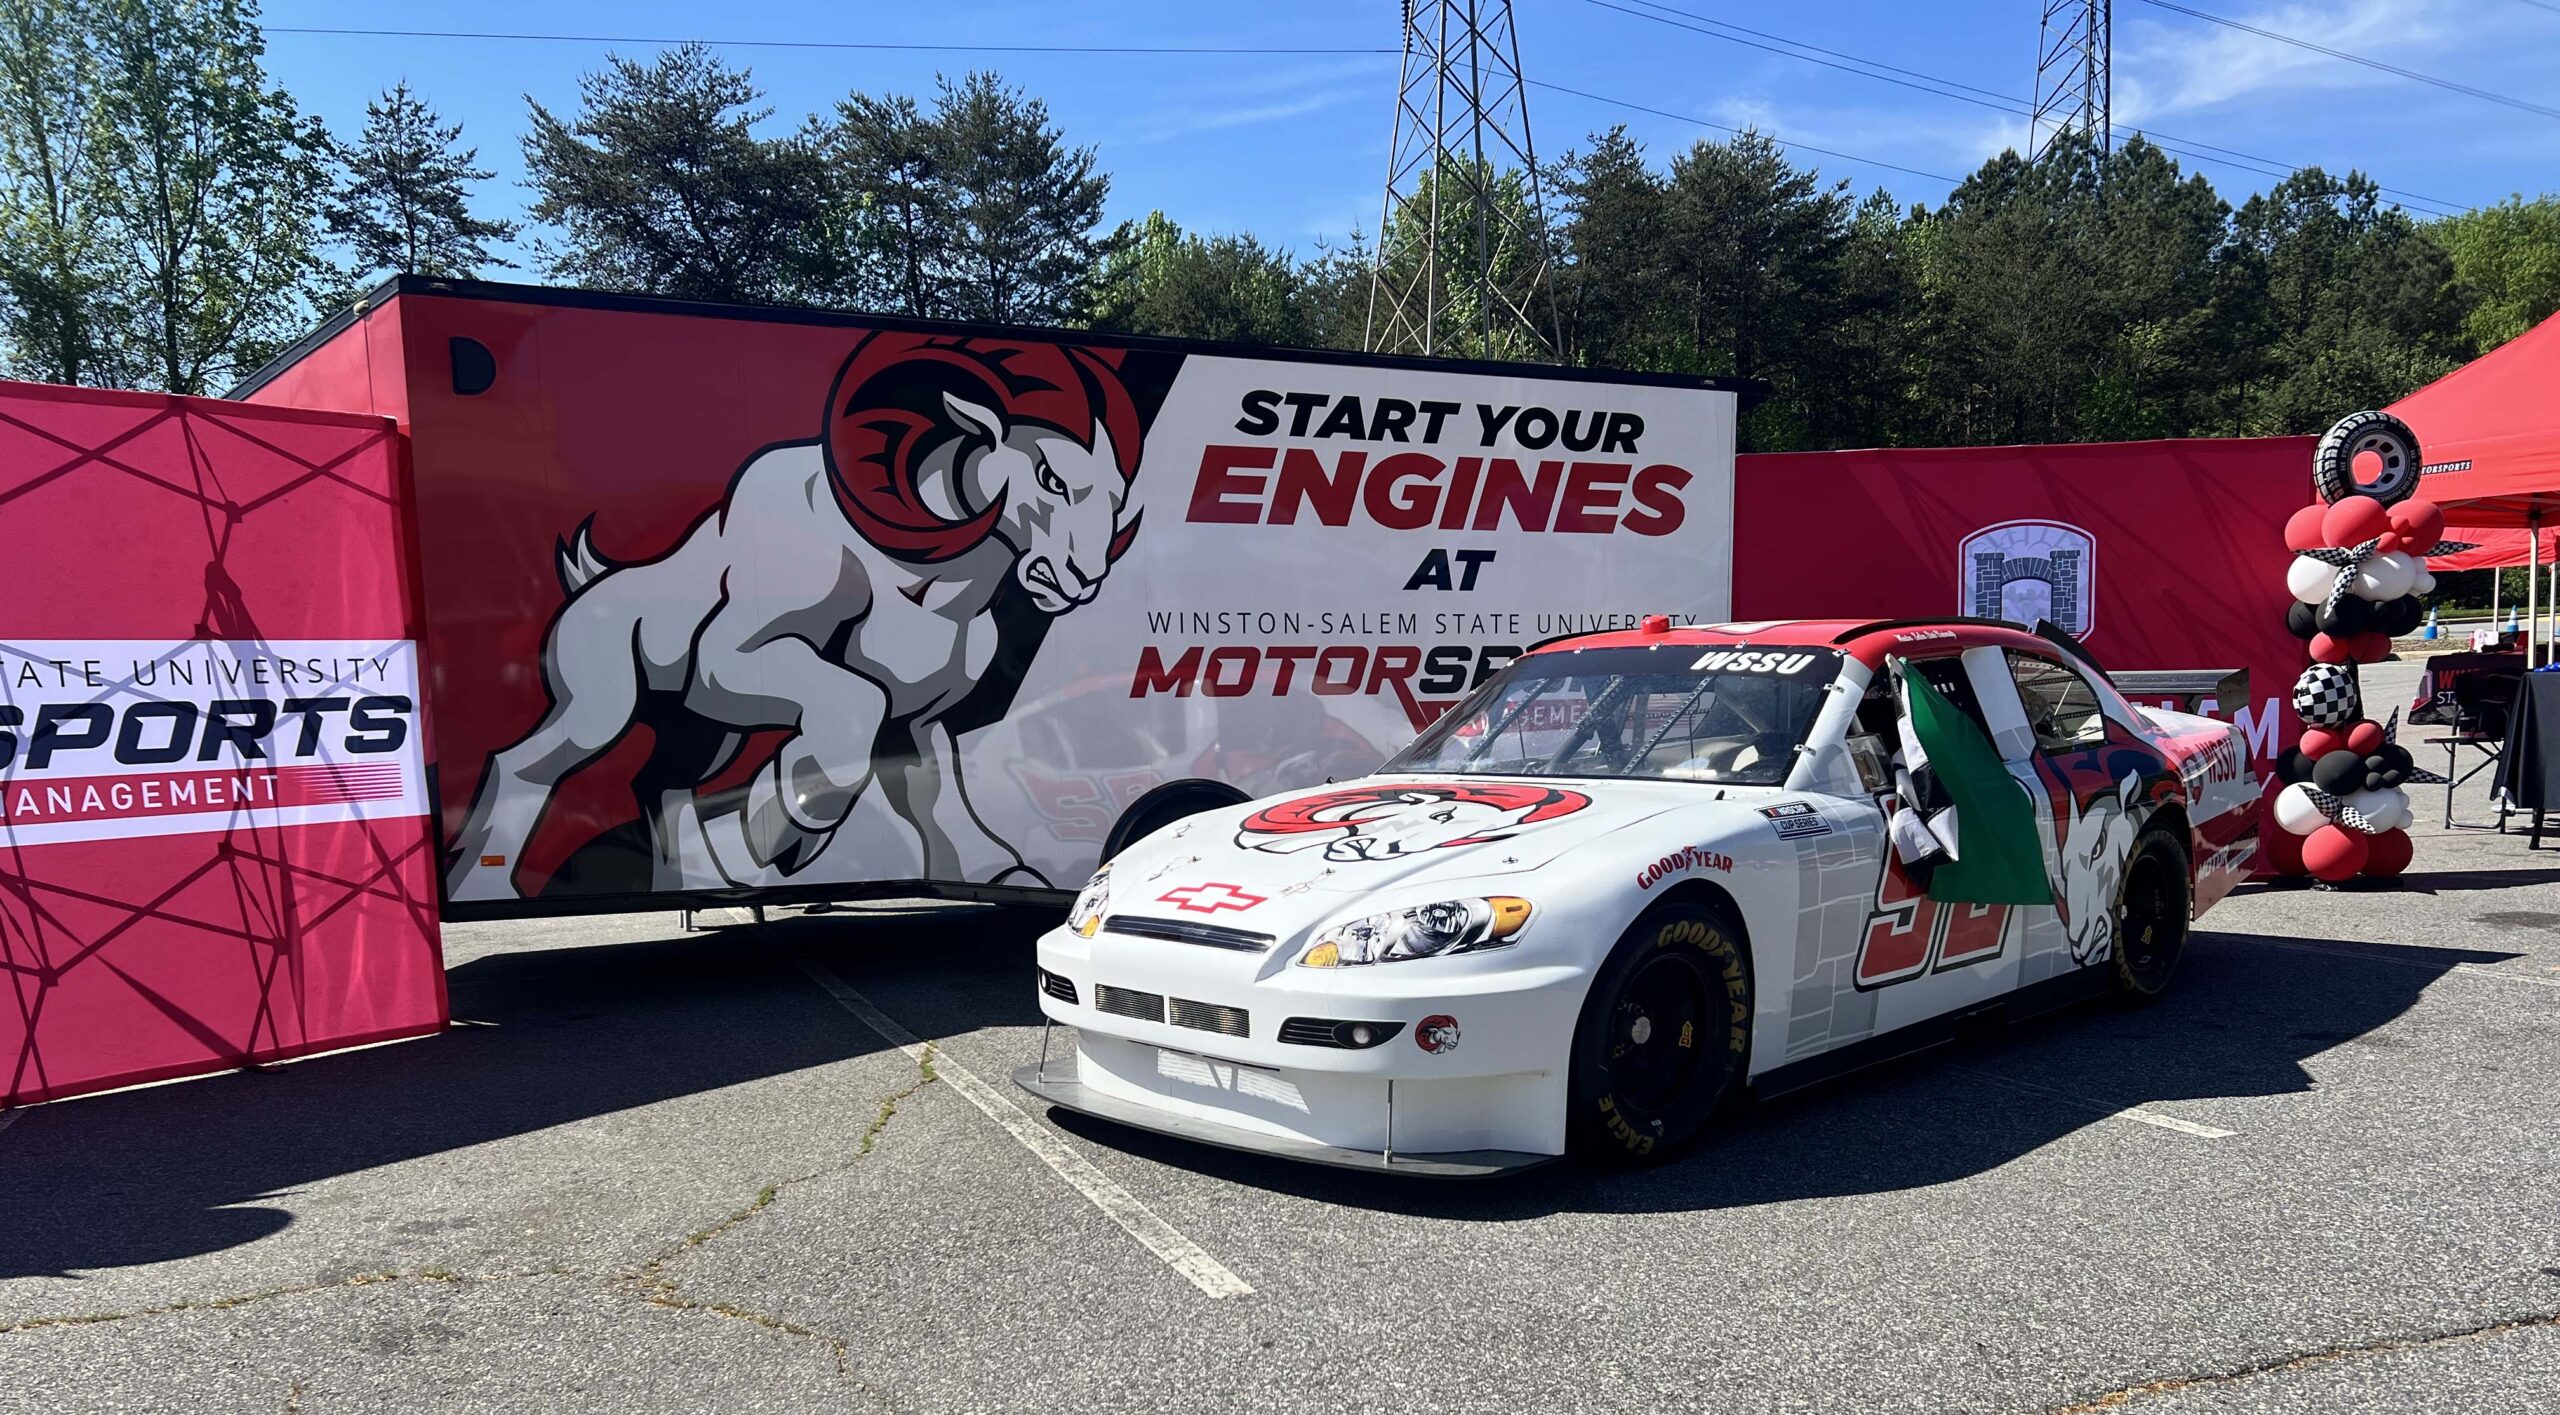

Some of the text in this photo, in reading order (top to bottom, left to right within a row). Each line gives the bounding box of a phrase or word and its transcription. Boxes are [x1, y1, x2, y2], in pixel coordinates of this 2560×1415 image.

[1234, 388, 1645, 454] START YOUR
[1185, 444, 1694, 537] ENGINES
[1402, 548, 1497, 592] AT
[1147, 611, 1697, 635] WINSTON-SALEM STATE UNIVERTY
[133, 656, 390, 686] UNIVERSITY
[1690, 651, 1816, 674] WSSU
[2194, 737, 2237, 785] WSSU
[0, 774, 279, 818] ANAGEMENT
[1780, 816, 1819, 830] CUP SERIES
[1597, 1094, 1655, 1155] EAGLE
